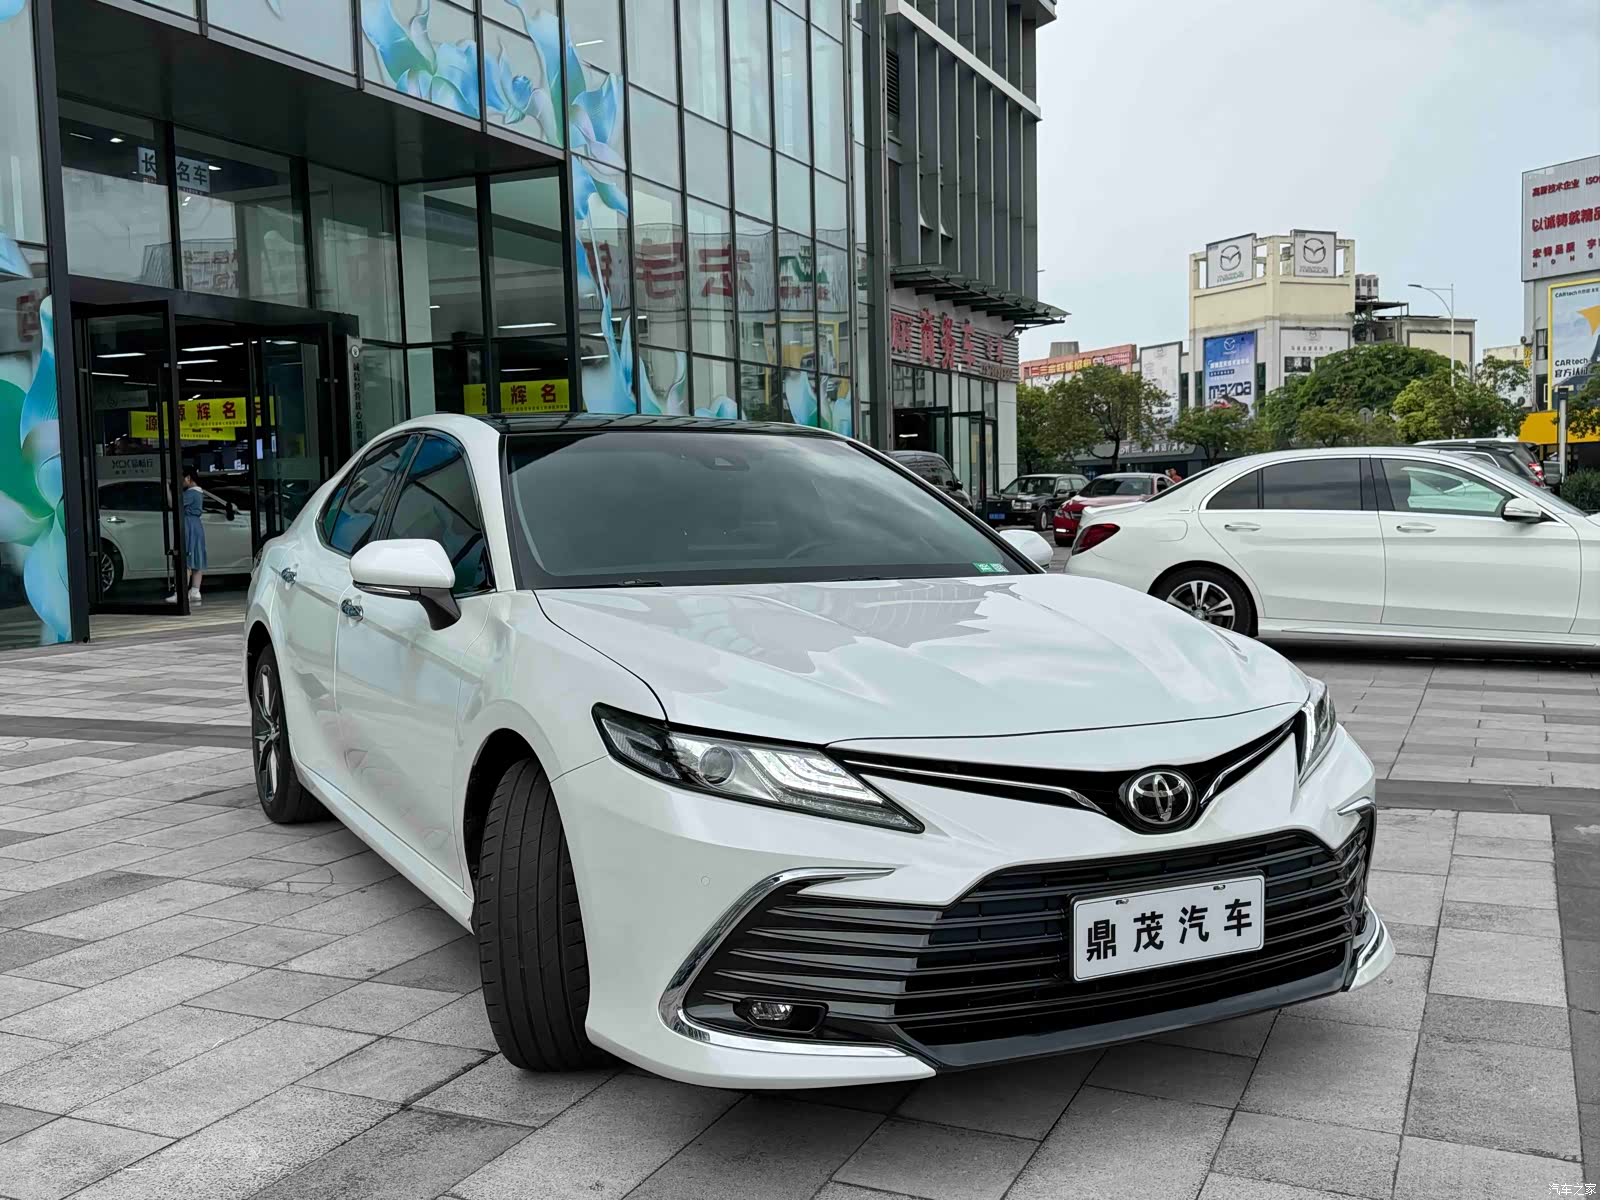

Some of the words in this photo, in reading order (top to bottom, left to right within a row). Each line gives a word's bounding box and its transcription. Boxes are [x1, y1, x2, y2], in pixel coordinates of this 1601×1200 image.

[1586, 176, 1600, 185] ISO
[1555, 357, 1588, 367] CARtech
[1208, 381, 1252, 399] mazda
[1086, 898, 1253, 961] 鼎茂汽车
